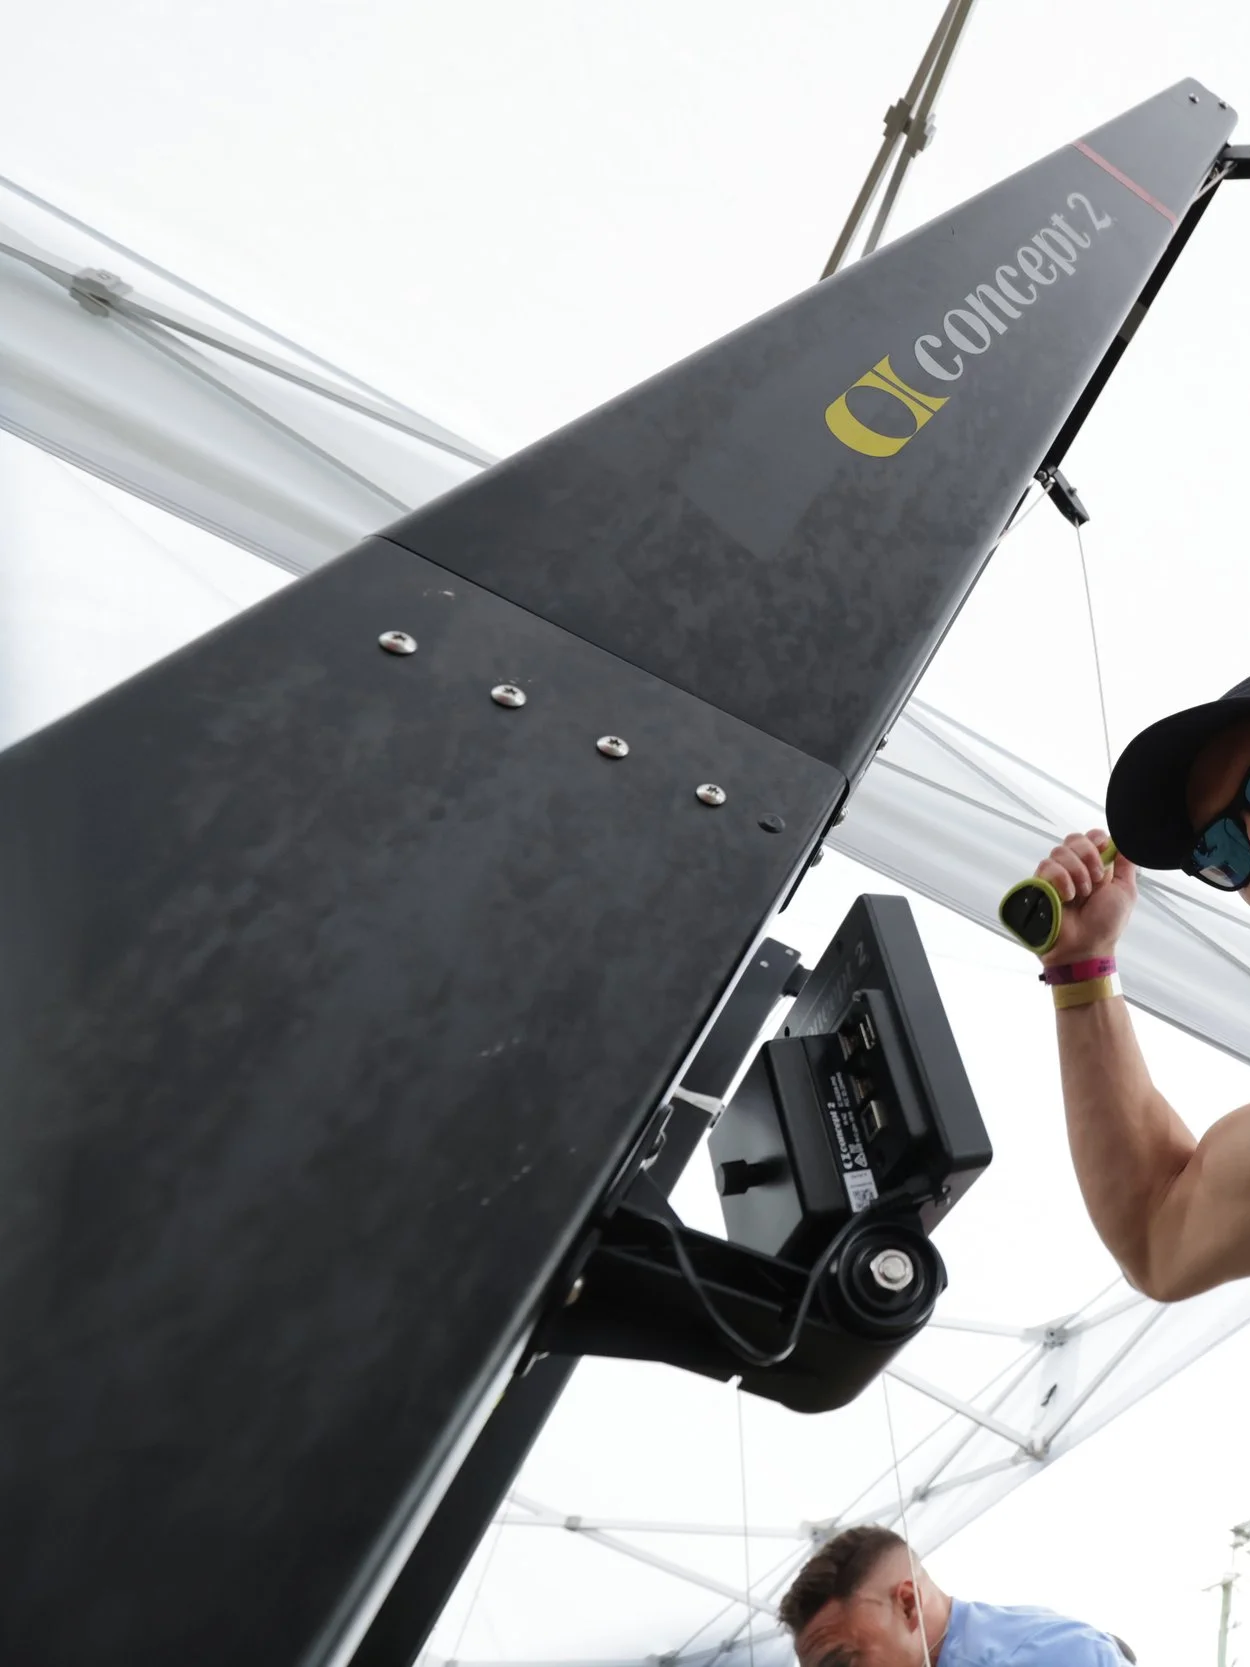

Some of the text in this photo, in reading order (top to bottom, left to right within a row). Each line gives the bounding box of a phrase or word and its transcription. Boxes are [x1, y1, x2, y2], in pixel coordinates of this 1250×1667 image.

[914, 192, 1112, 381] concept 2
[855, 941, 867, 967] 2
[827, 1102, 836, 1110] 2
[830, 1110, 848, 1153] concept
